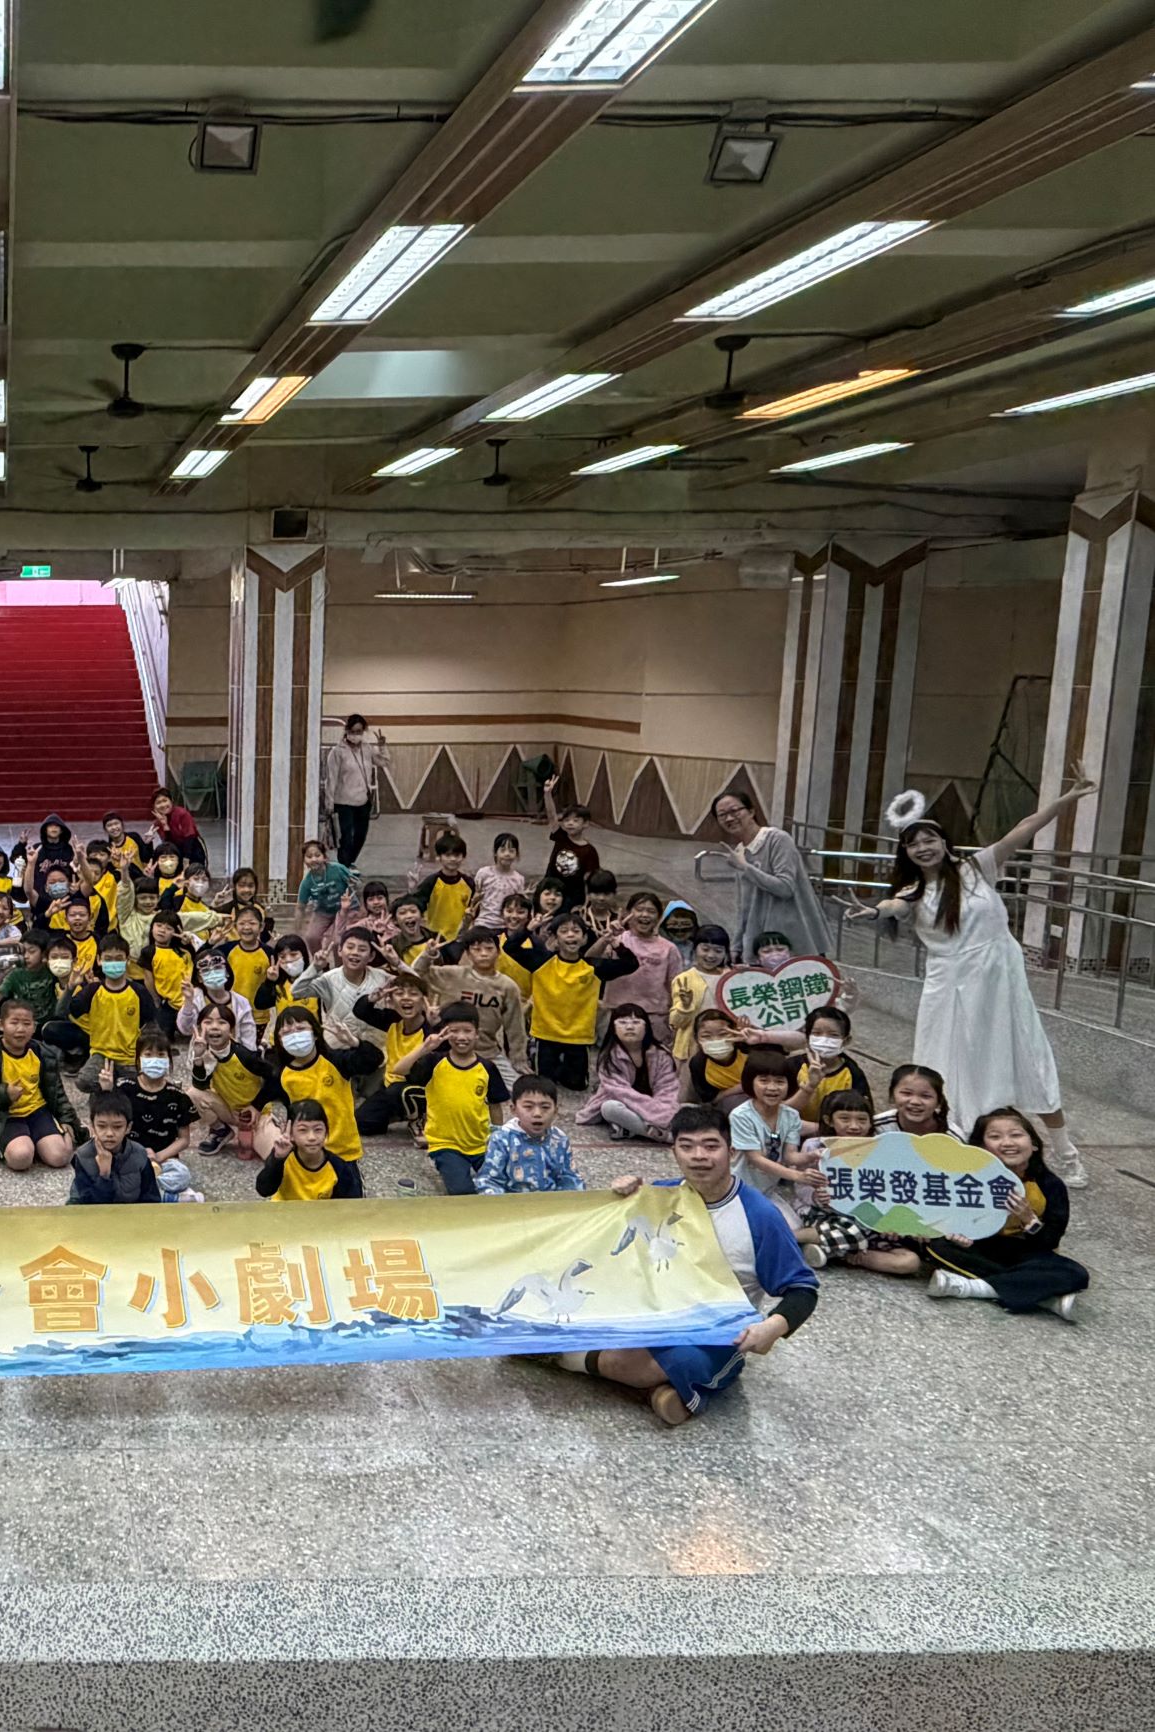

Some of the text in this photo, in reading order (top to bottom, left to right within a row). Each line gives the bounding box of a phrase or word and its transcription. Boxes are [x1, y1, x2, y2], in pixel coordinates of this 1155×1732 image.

[461, 990, 500, 1008] FILA
[727, 972, 831, 1010] 長榮鋼鐵
[757, 999, 809, 1028] 公司
[826, 1167, 1016, 1210] 張榮發基金會
